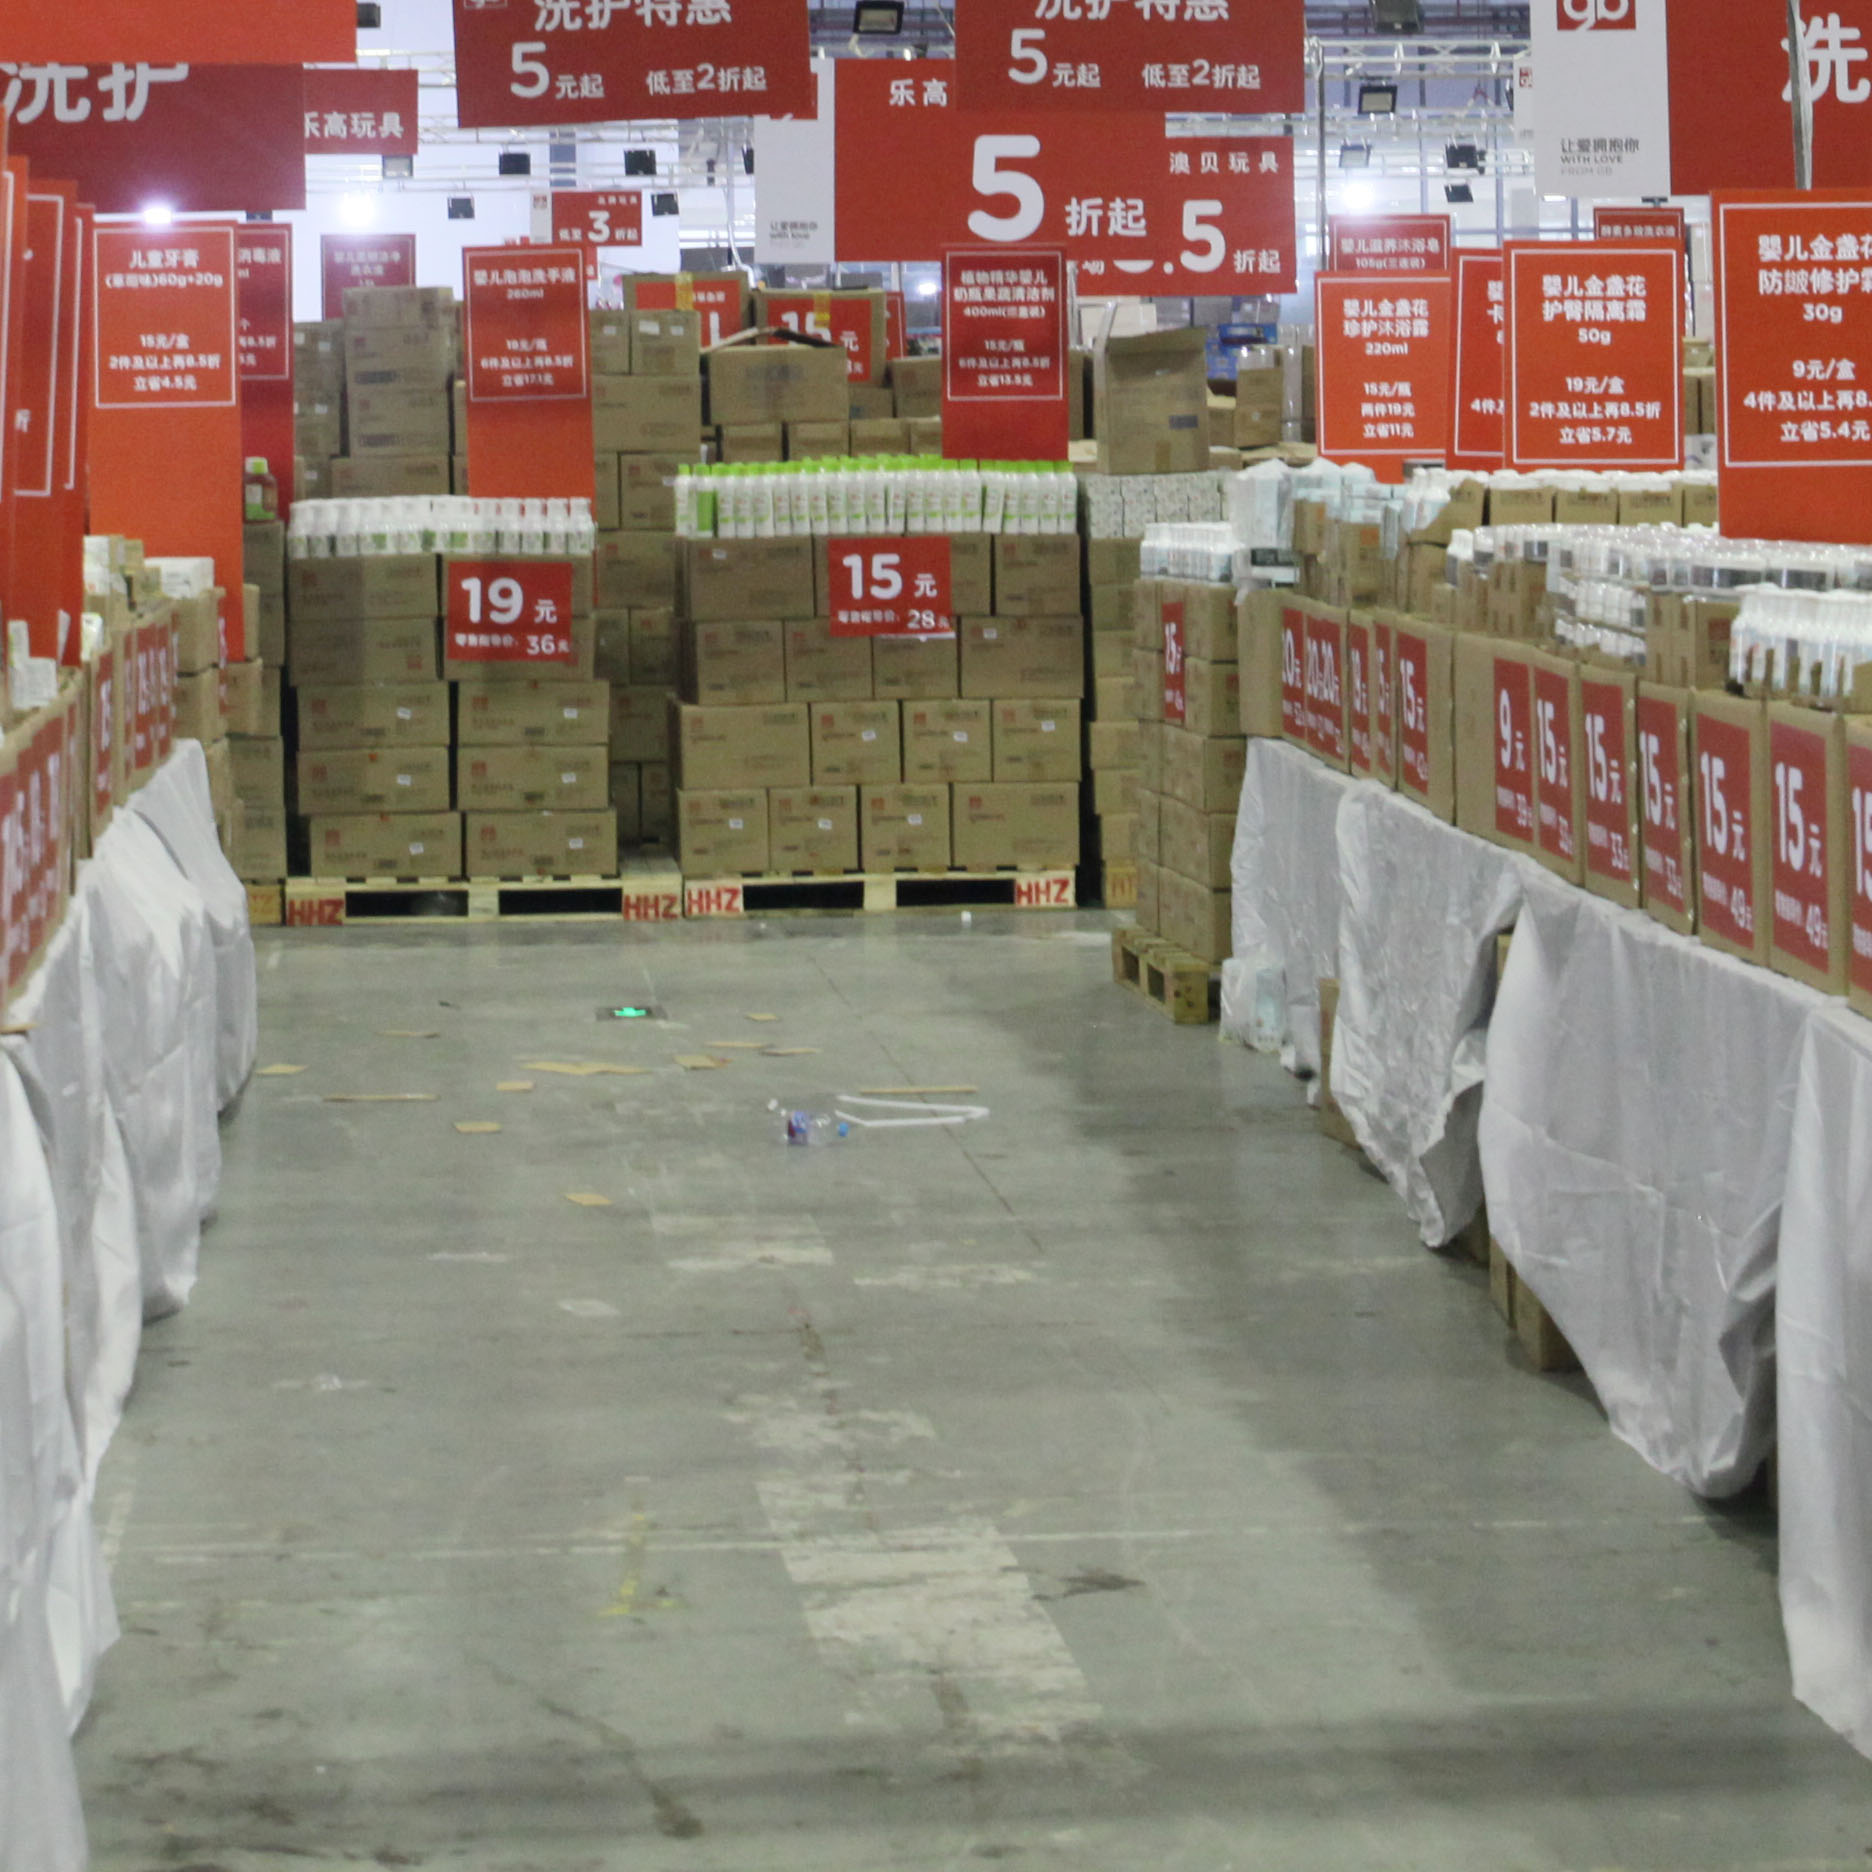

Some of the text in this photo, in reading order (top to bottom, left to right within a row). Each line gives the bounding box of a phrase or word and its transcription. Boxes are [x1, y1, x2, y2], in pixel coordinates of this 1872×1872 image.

[511, 42, 766, 99] 5元起 低至2折起
[1008, 29, 1260, 89] 5元起 低至2折起
[968, 135, 1146, 242] 5折起
[1804, 303, 1842, 323] 30g
[1579, 328, 1611, 345] 50g
[1793, 358, 1855, 380] 9元/盒
[1781, 420, 1870, 441] 立省5.4元
[843, 554, 937, 599] 15元
[461, 577, 556, 623] 19元
[687, 887, 740, 914] HHZ
[1015, 878, 1070, 904] HHZ
[286, 897, 345, 926] HHZ
[622, 894, 678, 920] HHZ
